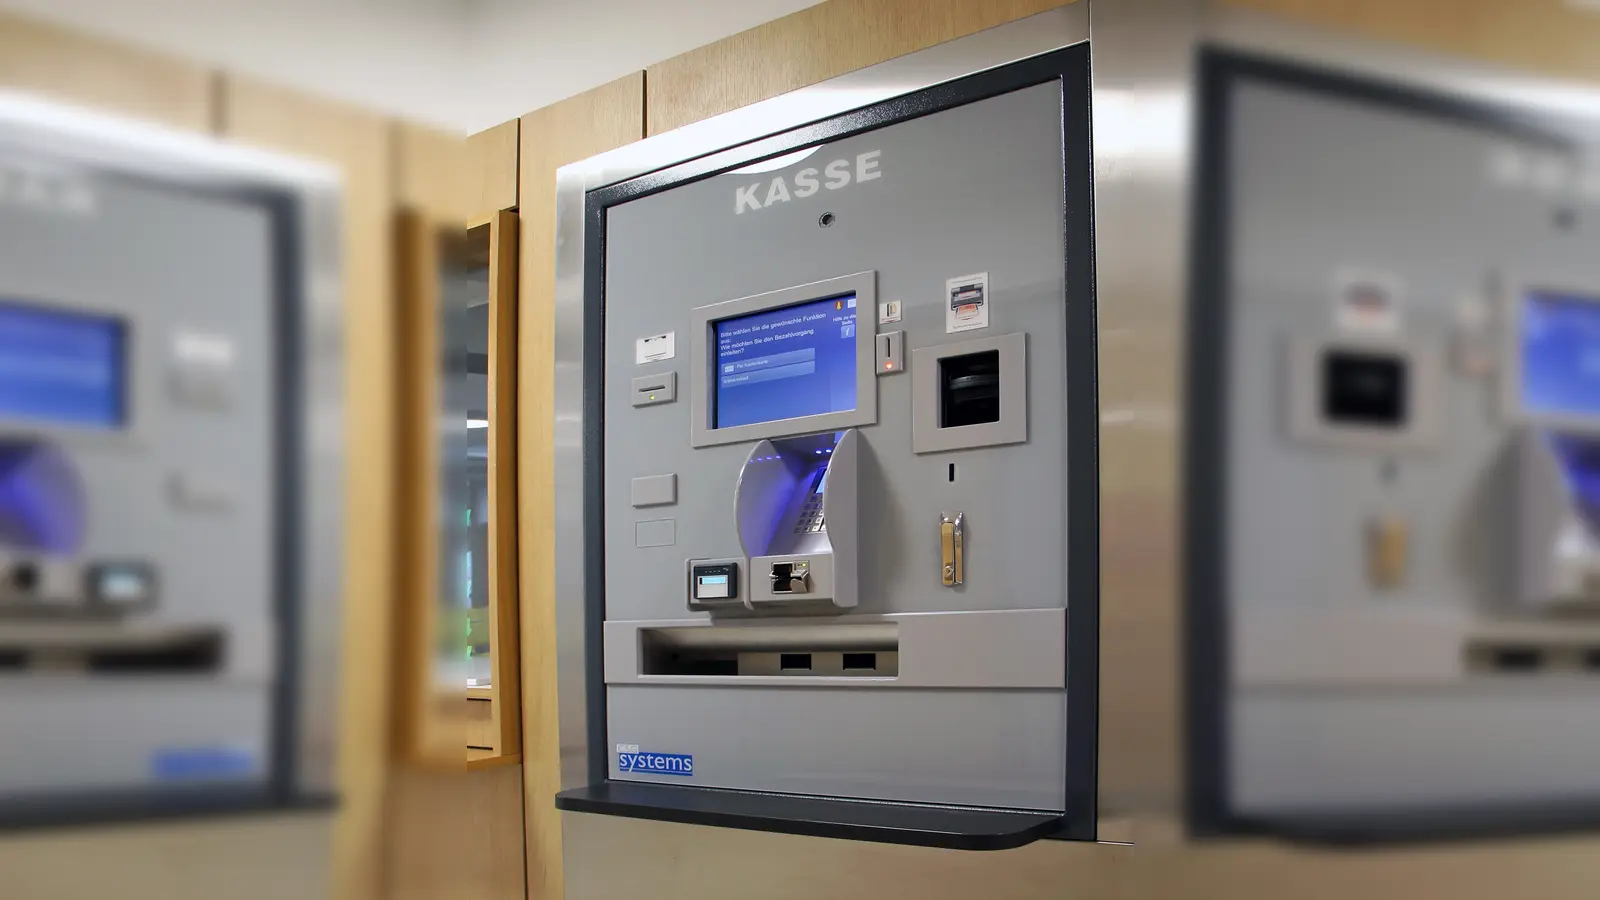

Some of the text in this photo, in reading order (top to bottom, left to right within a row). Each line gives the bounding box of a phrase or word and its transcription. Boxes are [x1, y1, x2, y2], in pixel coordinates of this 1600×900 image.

[734, 149, 882, 215] KASSE
[733, 328, 751, 336] wählen
[770, 318, 802, 329] gewünschte
[803, 313, 826, 321] Funktion
[731, 340, 753, 348] möchten
[774, 328, 814, 341] Bezahlvorgang
[720, 348, 744, 357] einleiten?
[619, 754, 692, 772] systems
